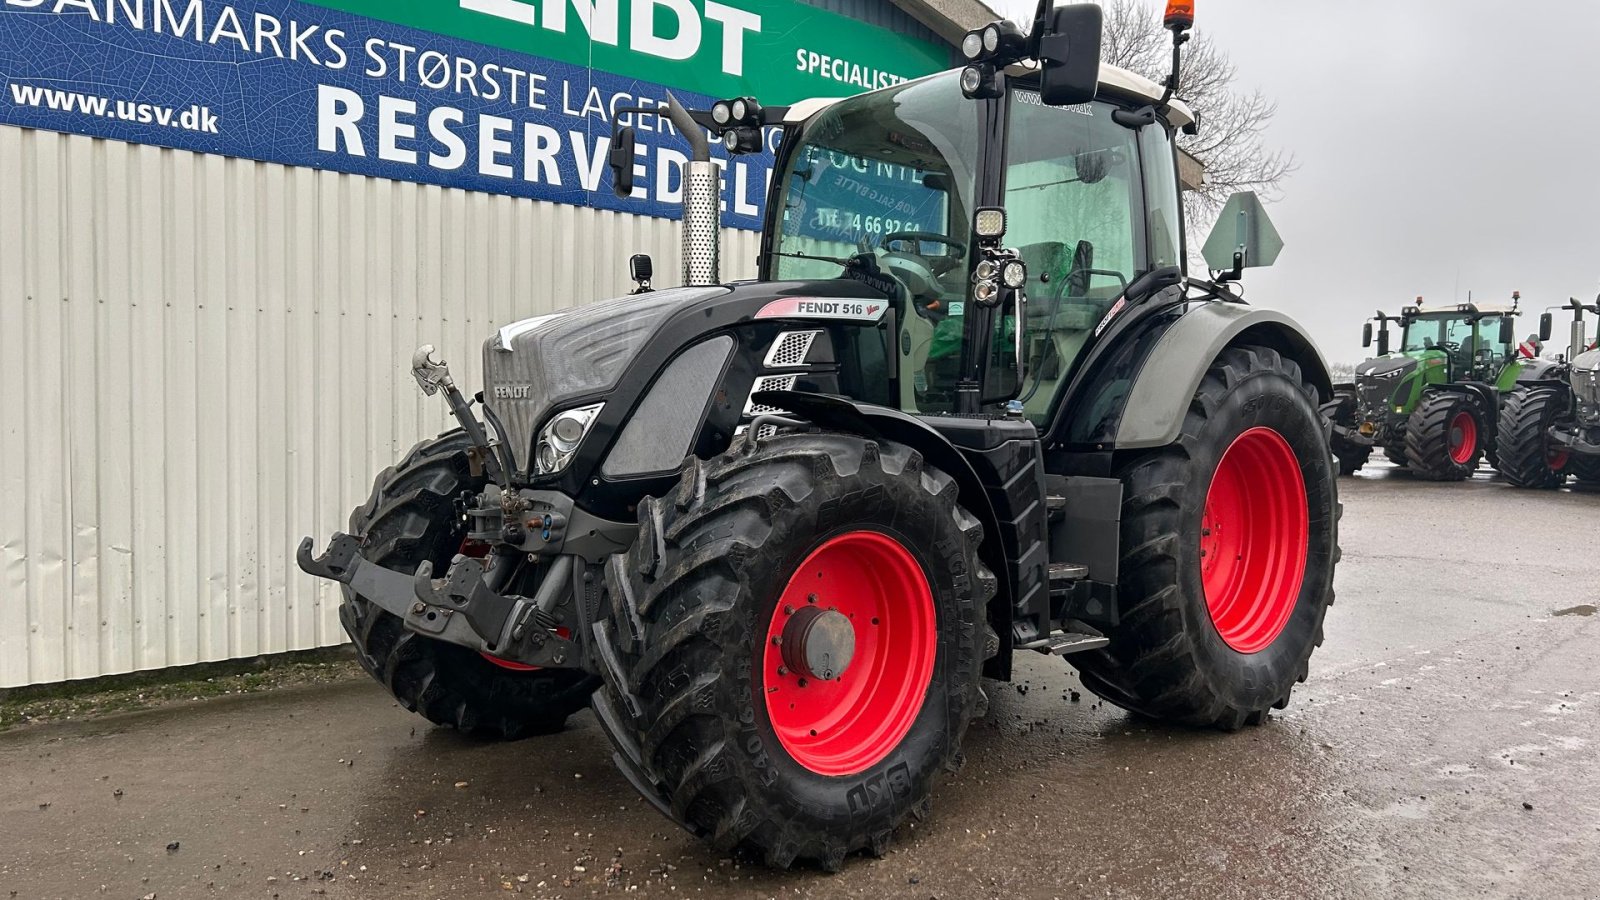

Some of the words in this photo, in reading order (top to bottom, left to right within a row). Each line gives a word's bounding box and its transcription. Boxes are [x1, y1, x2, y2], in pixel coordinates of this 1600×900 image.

[365, 37, 547, 110] STØRSTE
[562, 79, 676, 136] LAGER
[10, 82, 219, 135] www.usv.dk
[865, 215, 881, 234] 66
[798, 302, 839, 314] FENDT
[843, 303, 862, 315] 516
[494, 385, 531, 400] FENDT
[853, 767, 910, 814] BKT
